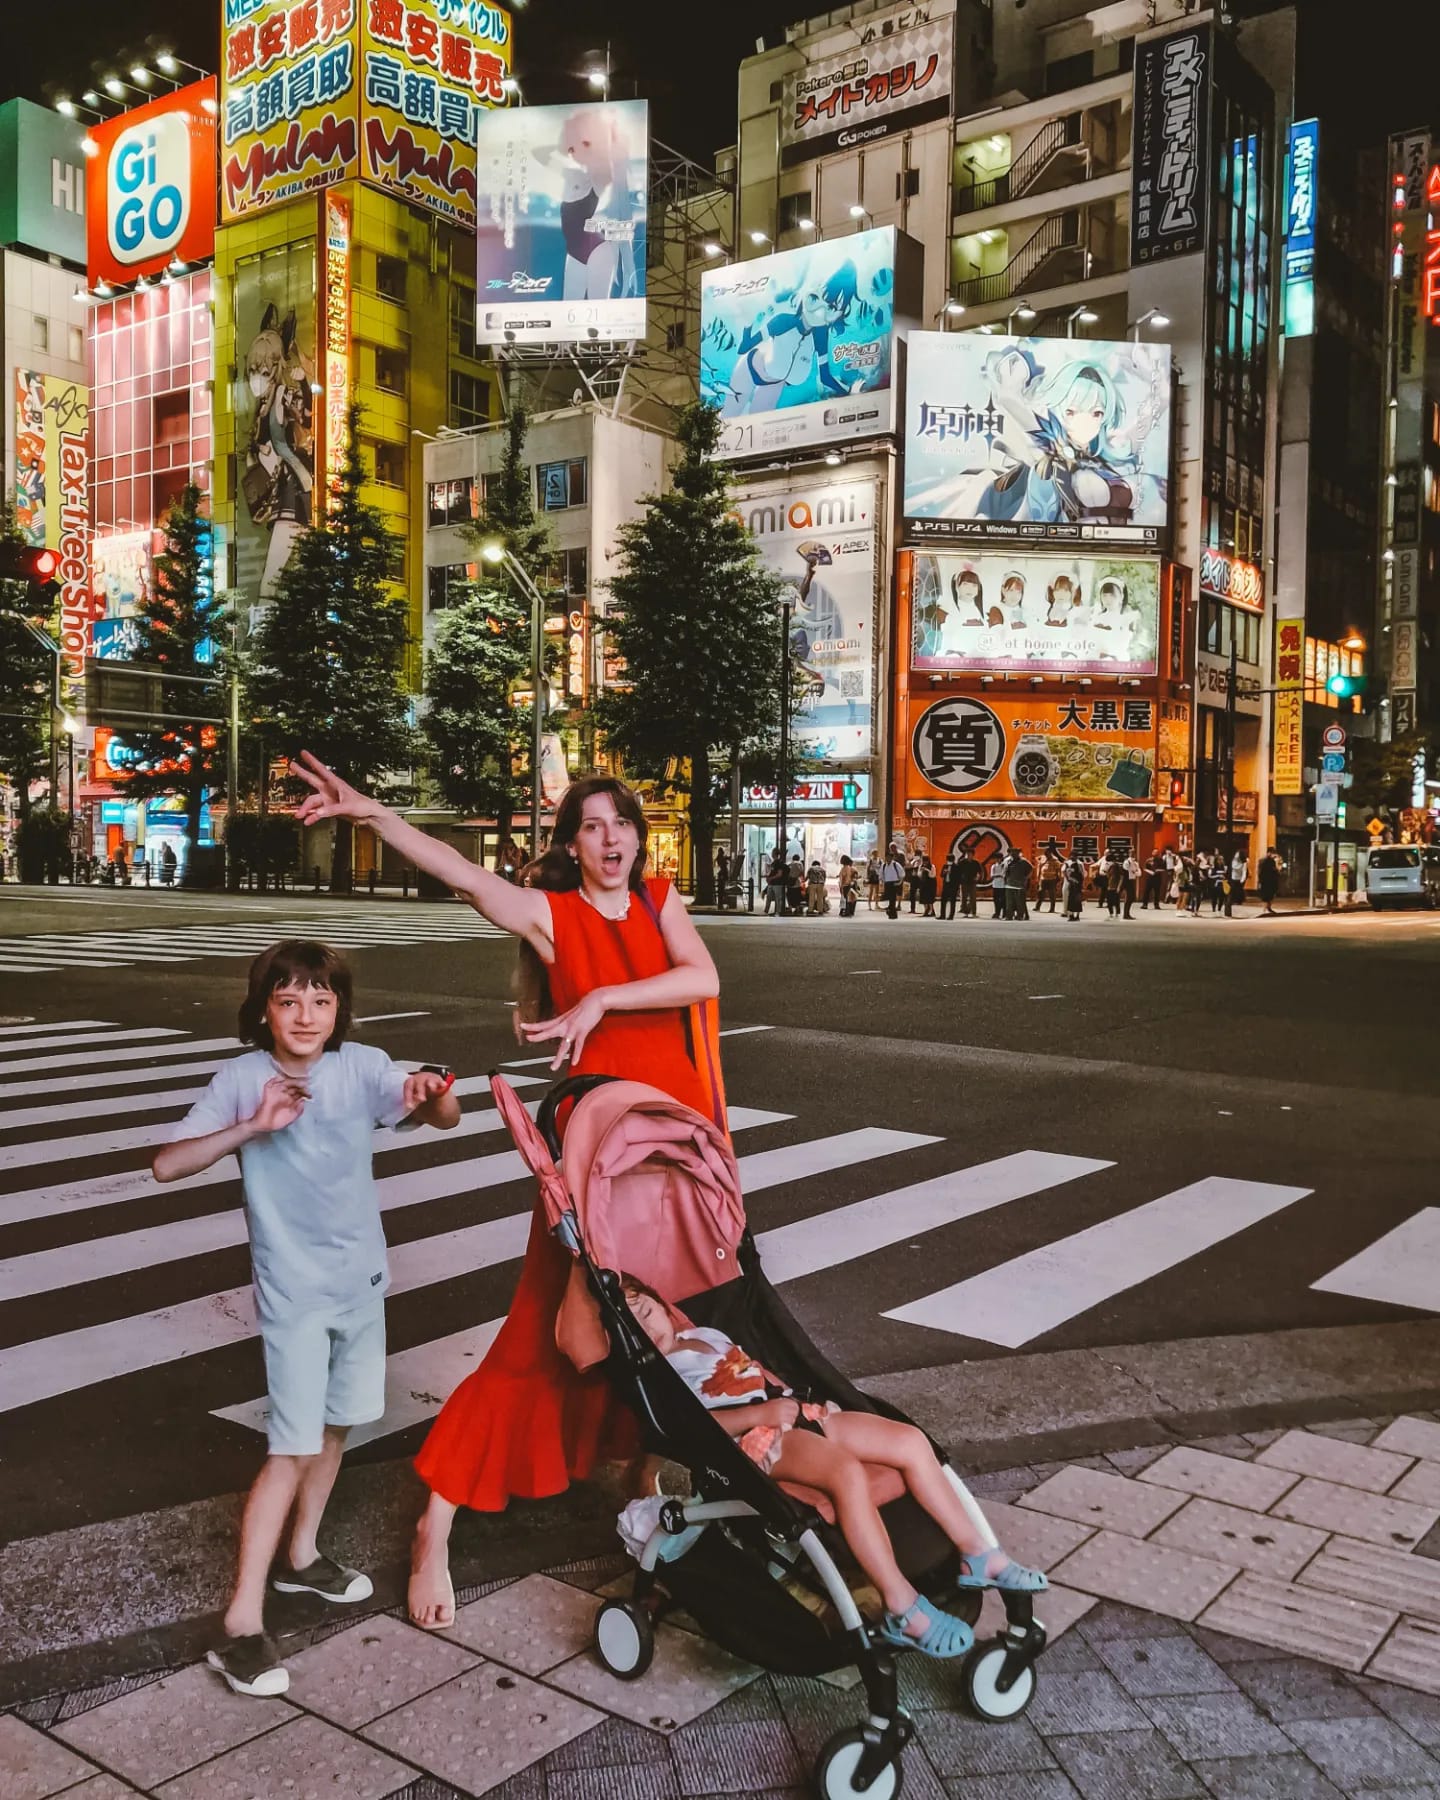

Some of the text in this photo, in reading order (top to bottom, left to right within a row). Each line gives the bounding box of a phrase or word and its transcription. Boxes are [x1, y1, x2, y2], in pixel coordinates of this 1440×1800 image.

[227, 0, 353, 80] 激安販売
[369, 0, 503, 98] 激安販売
[227, 41, 351, 142] 高額買取
[368, 55, 479, 143] 高額買
[795, 54, 939, 129] メイドカジノ
[52, 157, 84, 215] HI
[115, 134, 157, 193] Gi
[226, 113, 356, 210] Mulan
[365, 119, 478, 208] Mula
[115, 184, 182, 251] GO
[238, 191, 275, 213] ムーラン
[275, 181, 303, 199] AKIBA
[382, 172, 425, 200] ムーラン
[426, 194, 456, 216] AKIBA
[329, 252, 346, 265] DVD
[331, 285, 343, 297] CD
[735, 424, 753, 451] 21
[916, 394, 1005, 453] 原神
[843, 540, 869, 550] APEX
[924, 521, 1017, 535] PS5 PS4 Windows
[1005, 637, 1096, 651] at home cafe
[1012, 719, 1052, 729] チケット
[1057, 698, 1153, 732] 大黒屋
[1289, 723, 1300, 765] FREE
[925, 711, 994, 780] 質
[808, 783, 834, 799] ZIN
